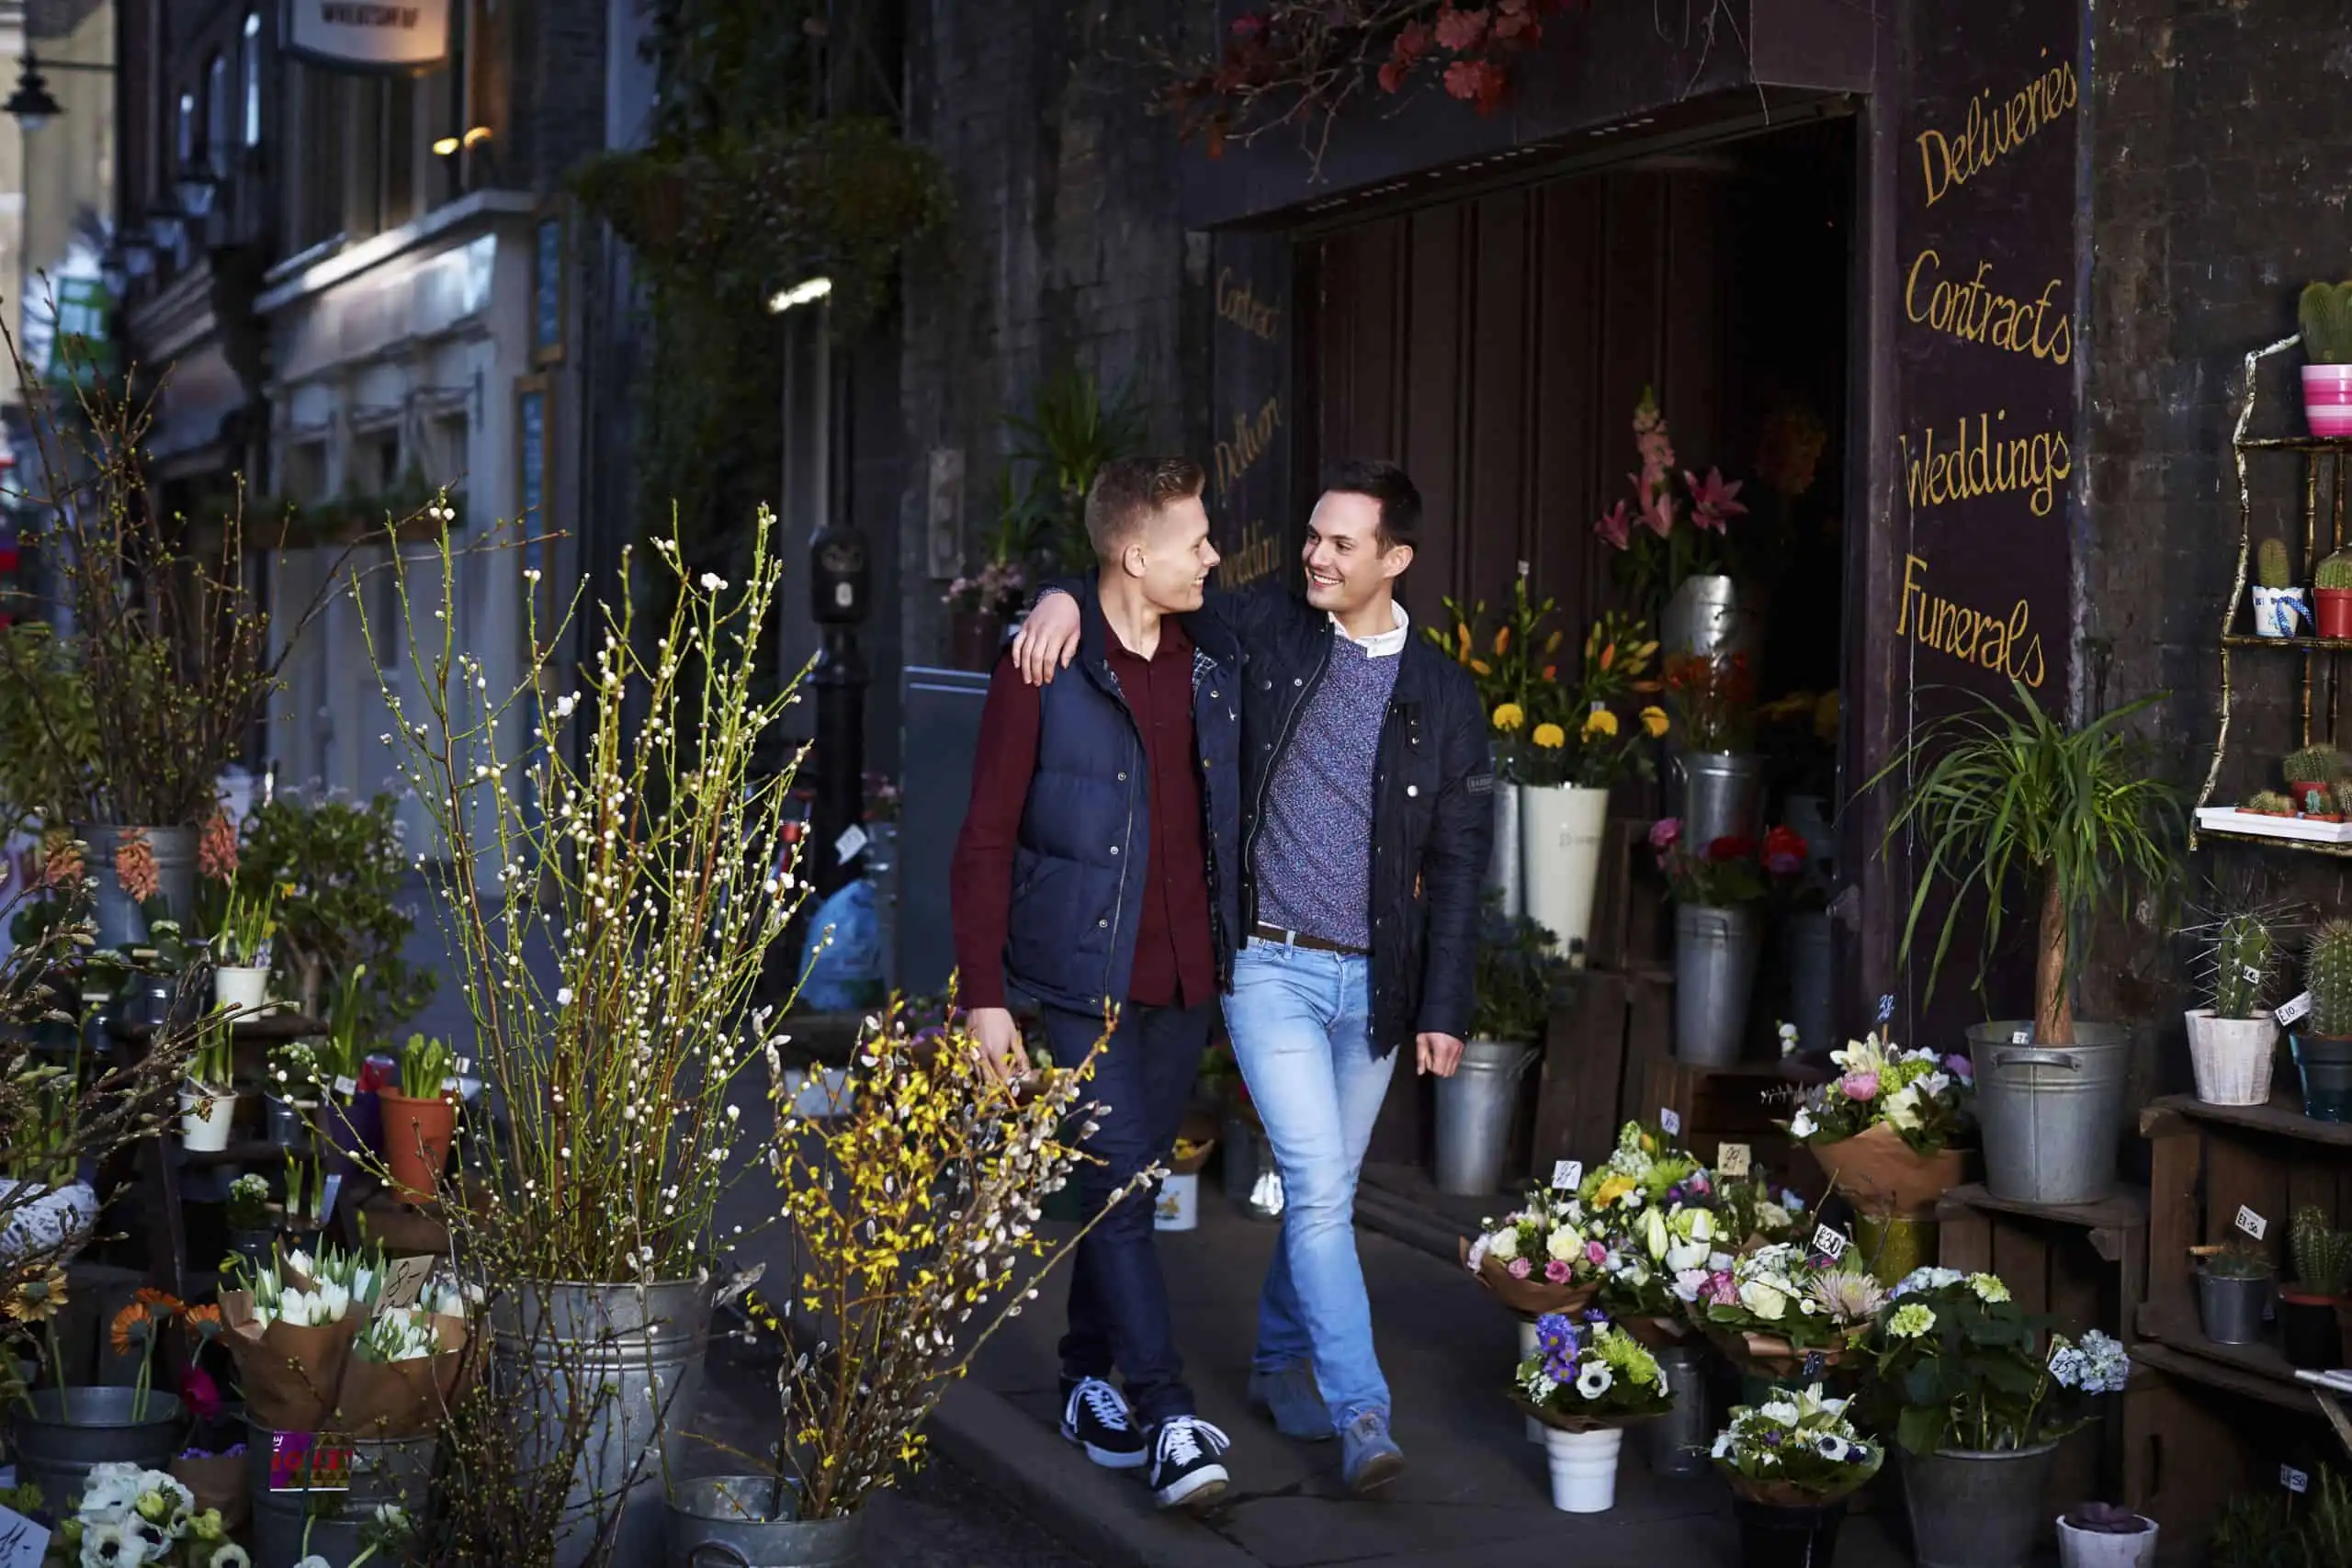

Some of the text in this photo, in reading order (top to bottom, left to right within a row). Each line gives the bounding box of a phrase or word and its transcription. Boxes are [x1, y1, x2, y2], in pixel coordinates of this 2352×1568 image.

[1917, 47, 2077, 208] Deliveries
[1906, 249, 2070, 365] Contracts
[1899, 410, 2071, 516] Weddings
[1895, 553, 2044, 689] Funerals
